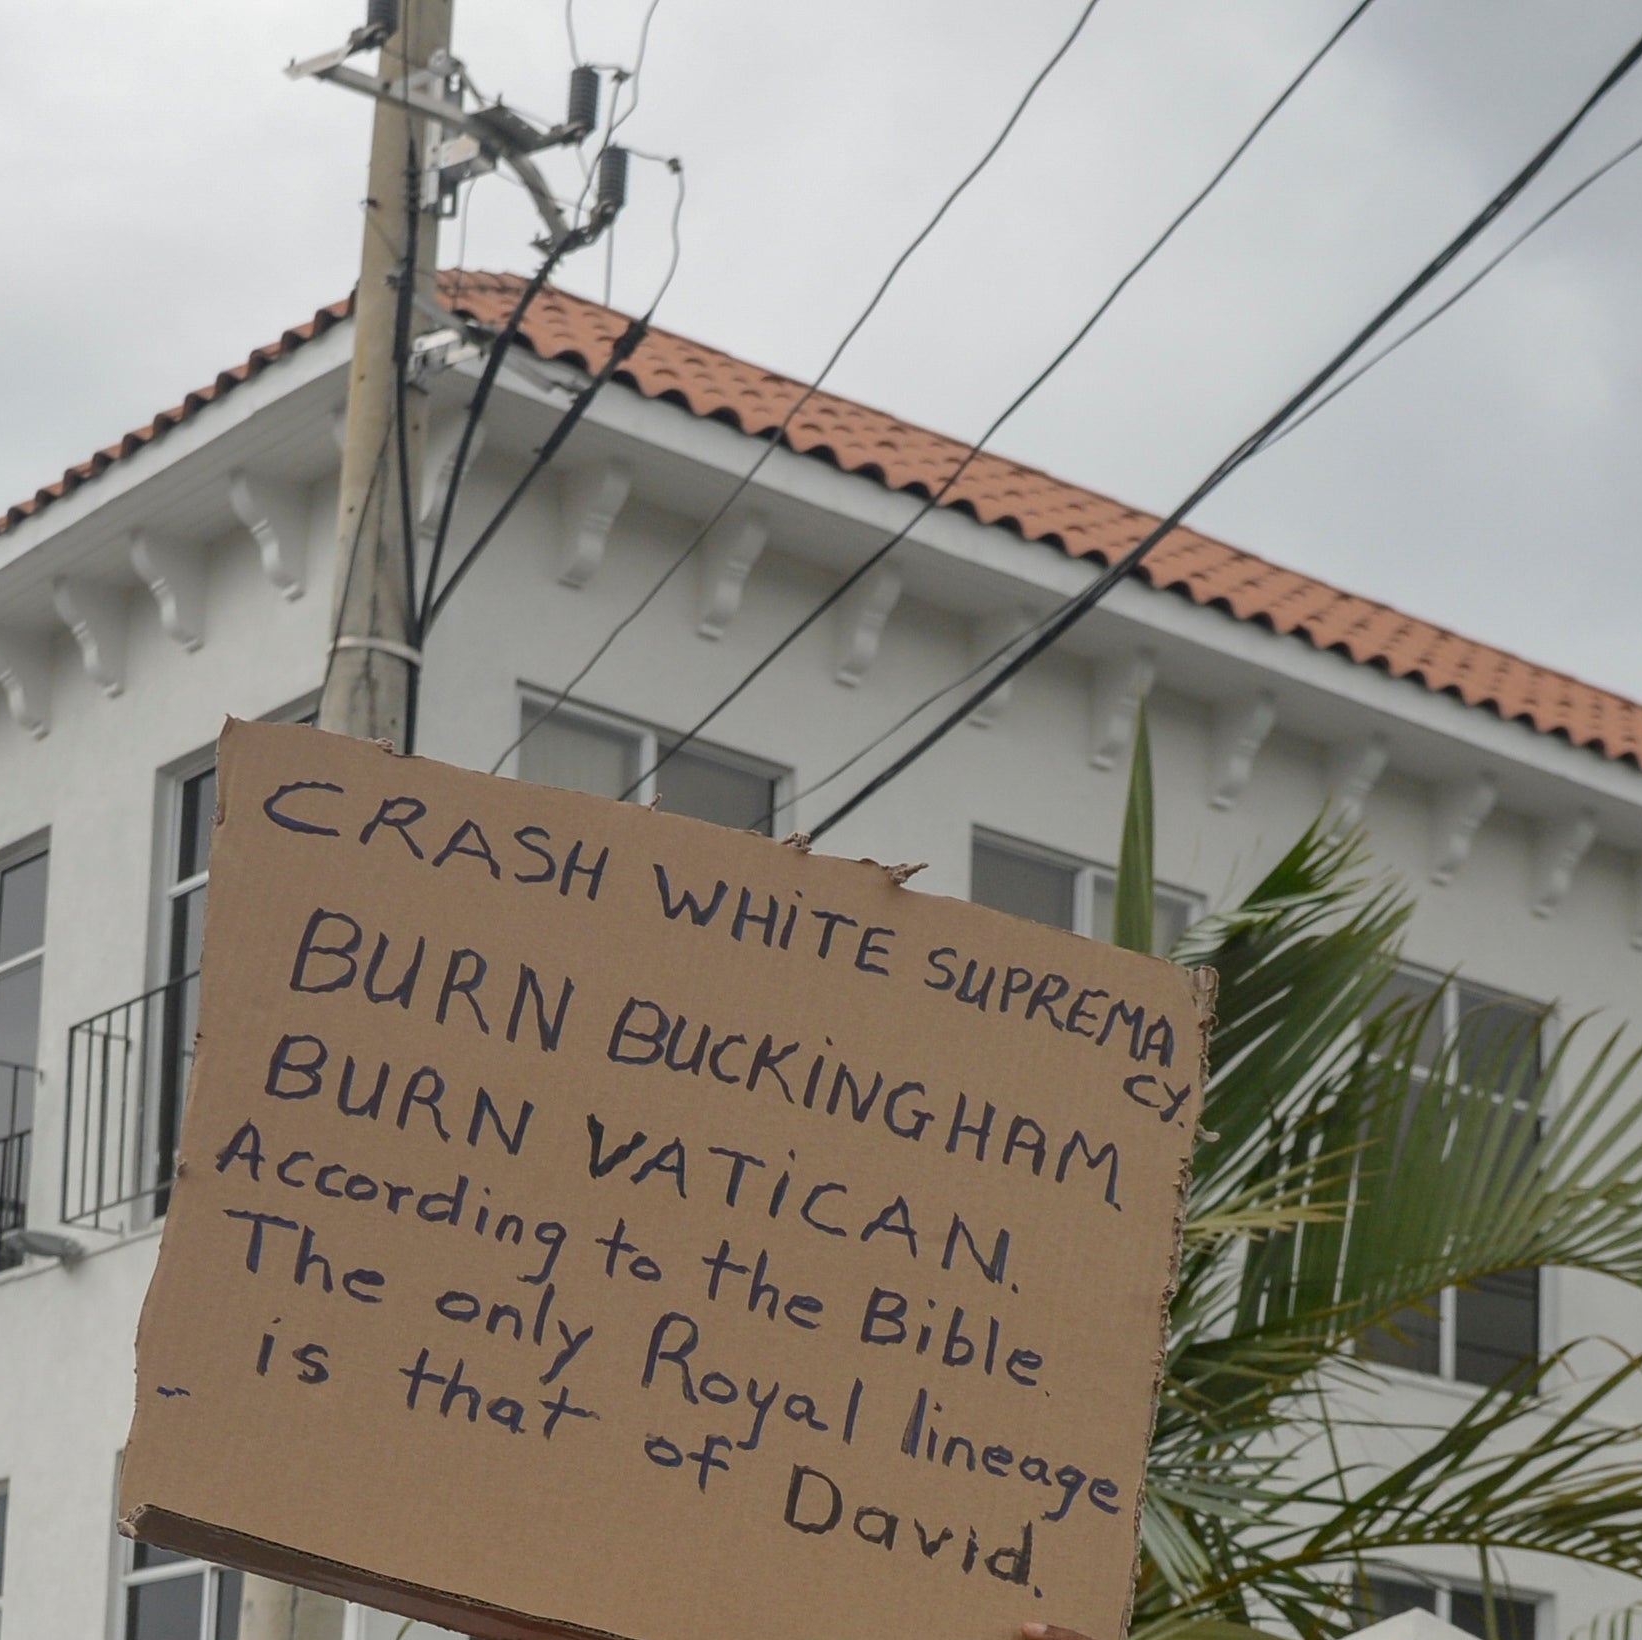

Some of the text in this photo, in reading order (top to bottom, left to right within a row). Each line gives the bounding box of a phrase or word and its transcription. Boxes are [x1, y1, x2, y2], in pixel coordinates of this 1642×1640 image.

[263, 781, 609, 901] CRASH
[289, 908, 575, 1052] BURN
[264, 1034, 534, 1156] BURN
[215, 1118, 568, 1285] According
[596, 1218, 663, 1282] to
[703, 1239, 824, 1330] the
[223, 1209, 1121, 1522] The only Royal lineage
[255, 1316, 1044, 1598] is that of David.
